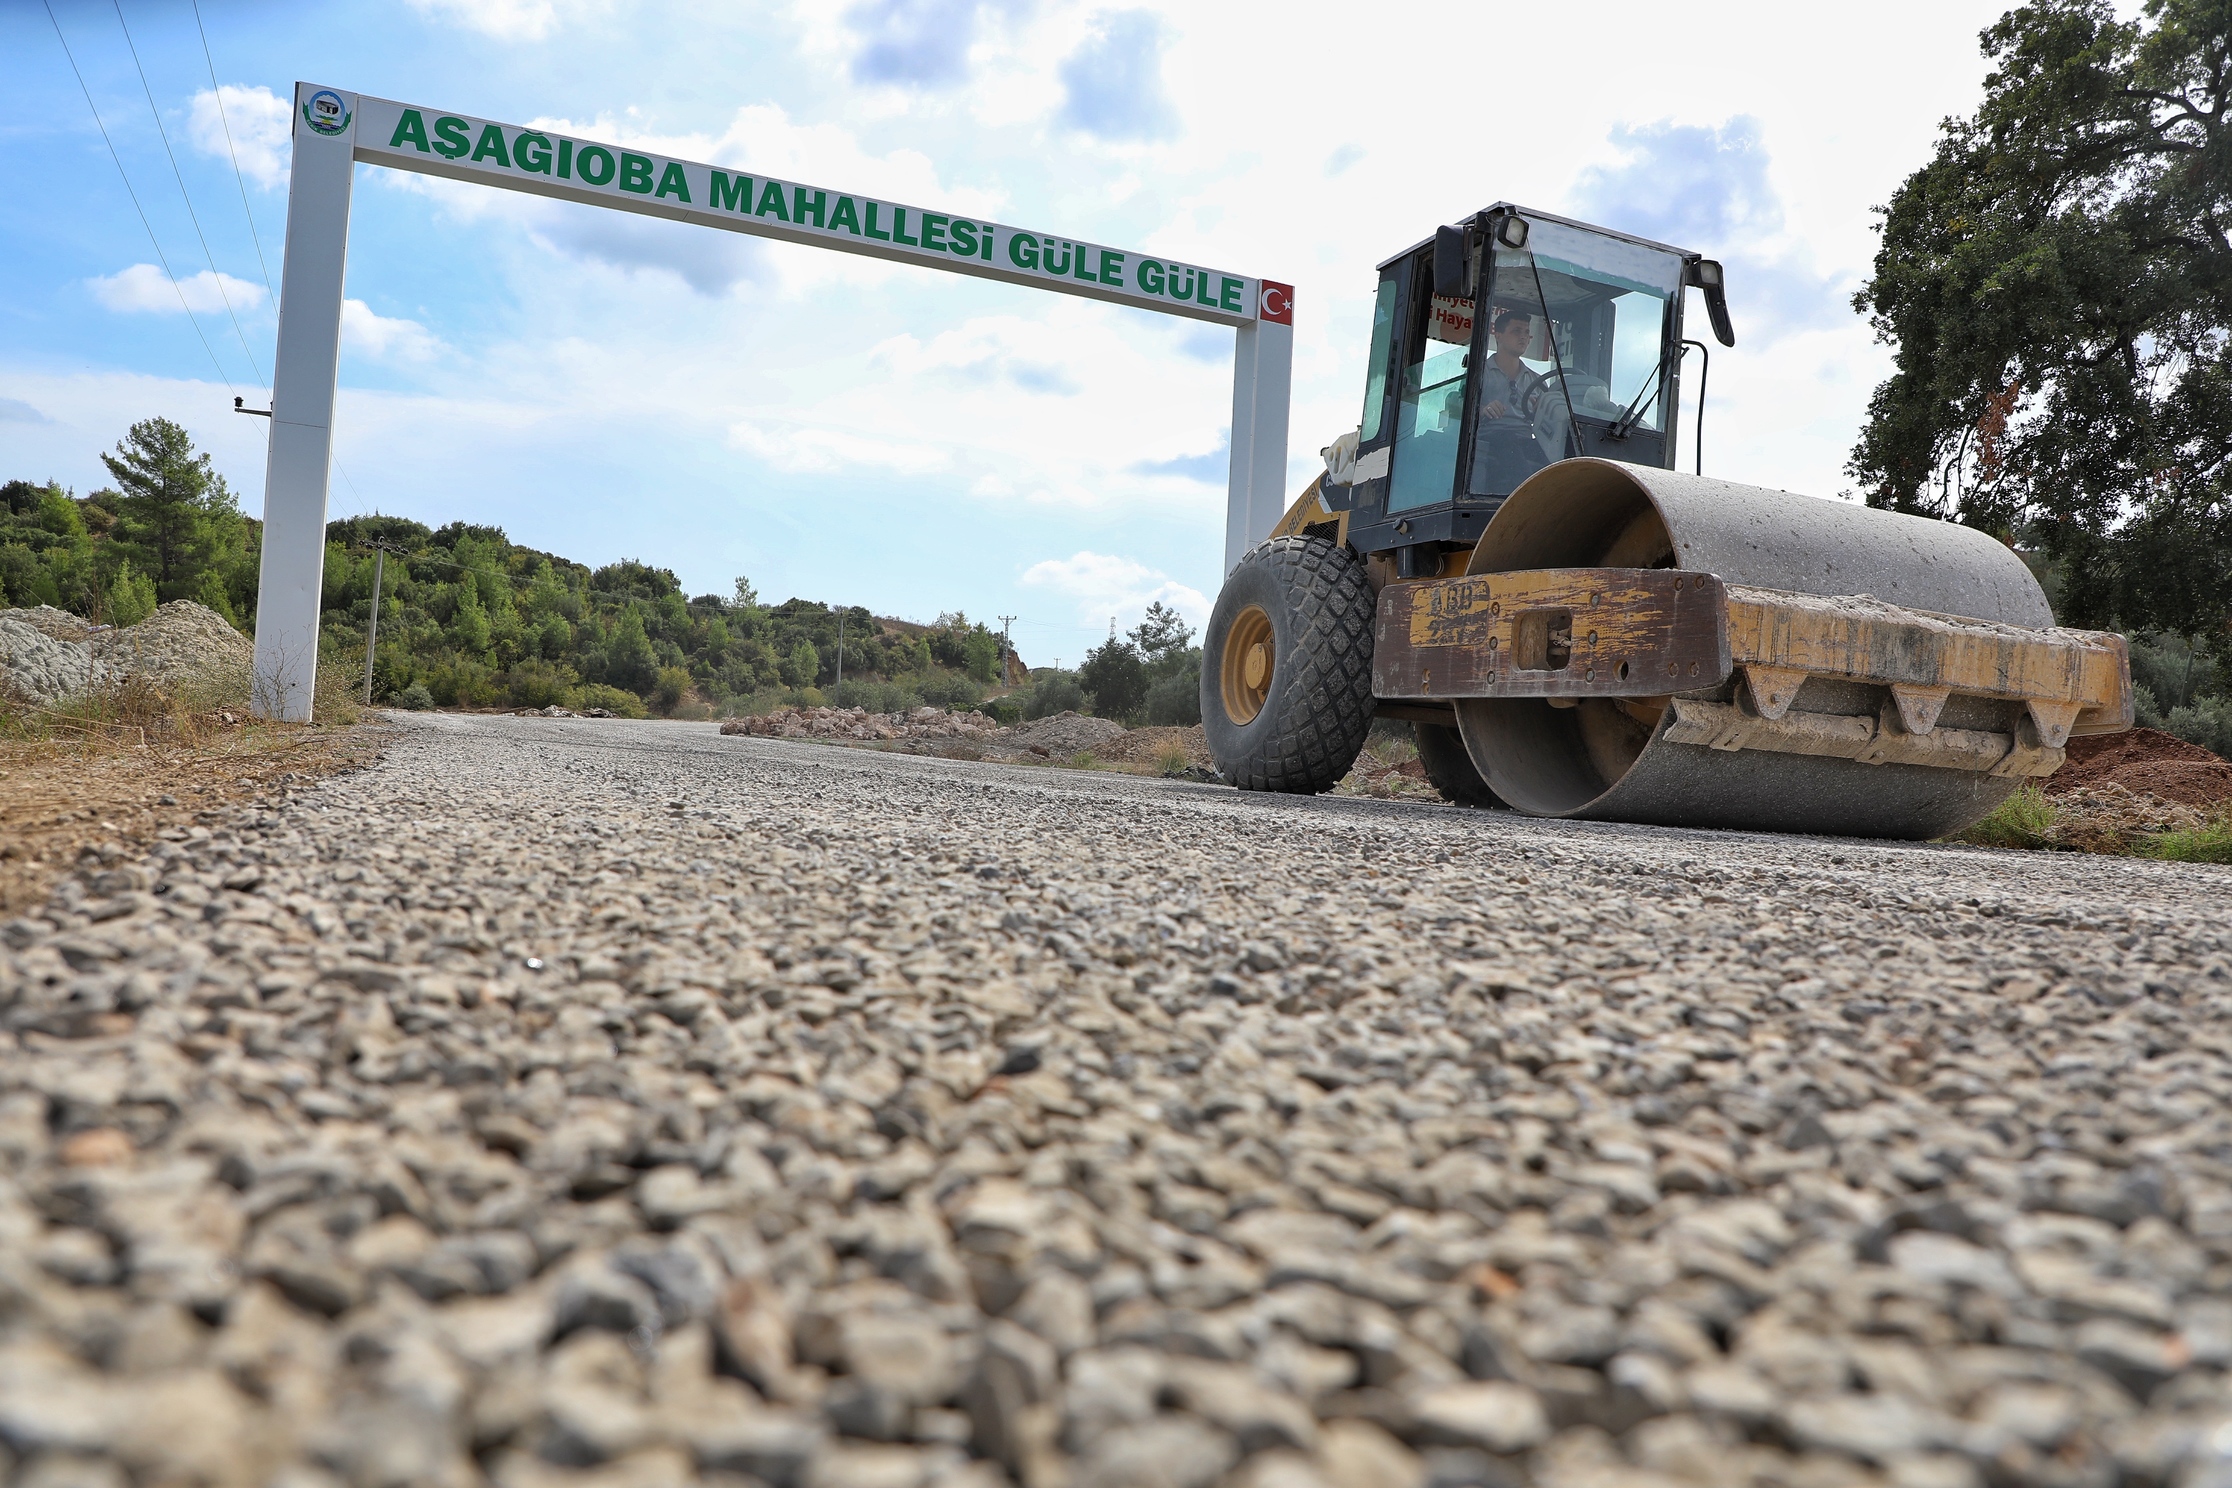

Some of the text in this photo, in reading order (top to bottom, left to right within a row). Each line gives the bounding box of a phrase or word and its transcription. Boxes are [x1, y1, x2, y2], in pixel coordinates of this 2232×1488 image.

[389, 109, 692, 204] AŞAĞIOBA
[1007, 233, 1125, 288] GÜLE
[1136, 260, 1245, 313] GÜLE
[1435, 308, 1474, 331] Haya
